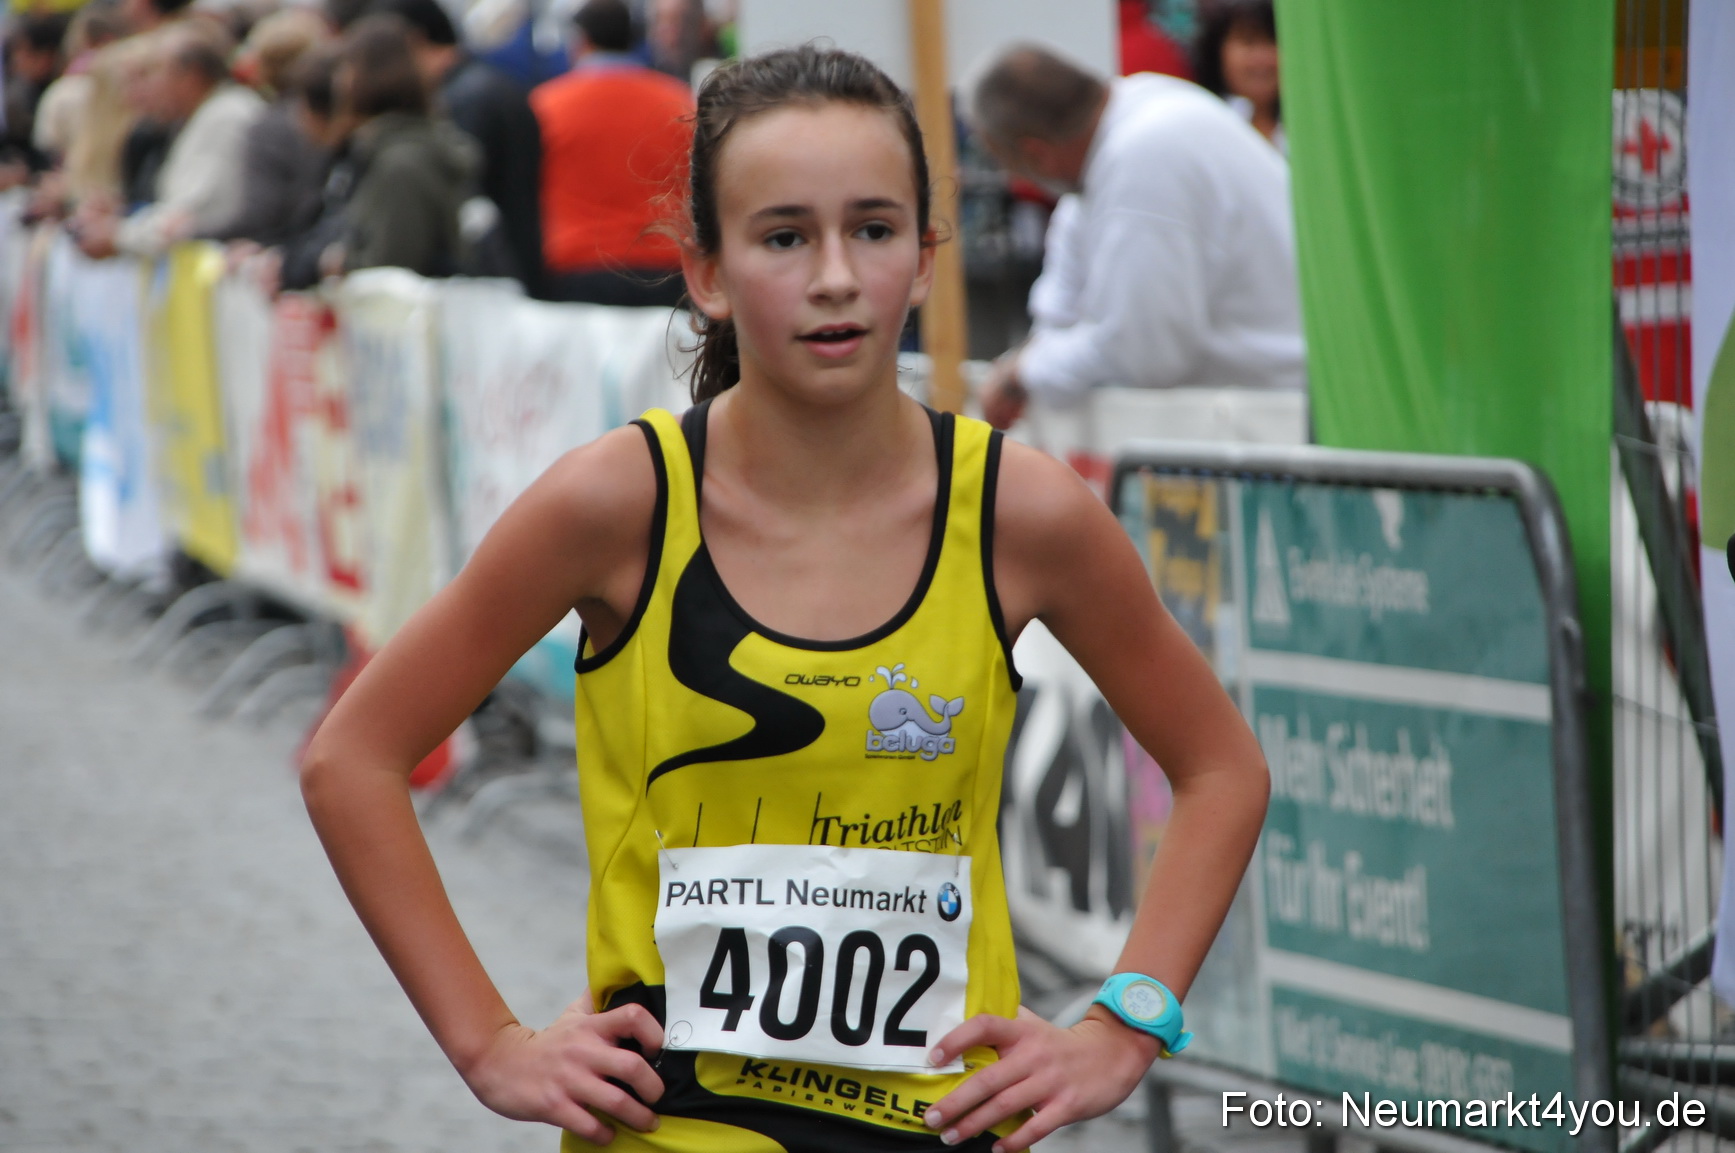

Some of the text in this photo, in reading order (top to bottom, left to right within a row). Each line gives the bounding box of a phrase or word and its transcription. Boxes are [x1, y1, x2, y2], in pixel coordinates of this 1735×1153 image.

[784, 673, 861, 687] owayo
[865, 730, 956, 762] beluga
[665, 878, 775, 908] PARTL
[786, 878, 927, 914] Neumarkt
[699, 925, 940, 1047] 4002
